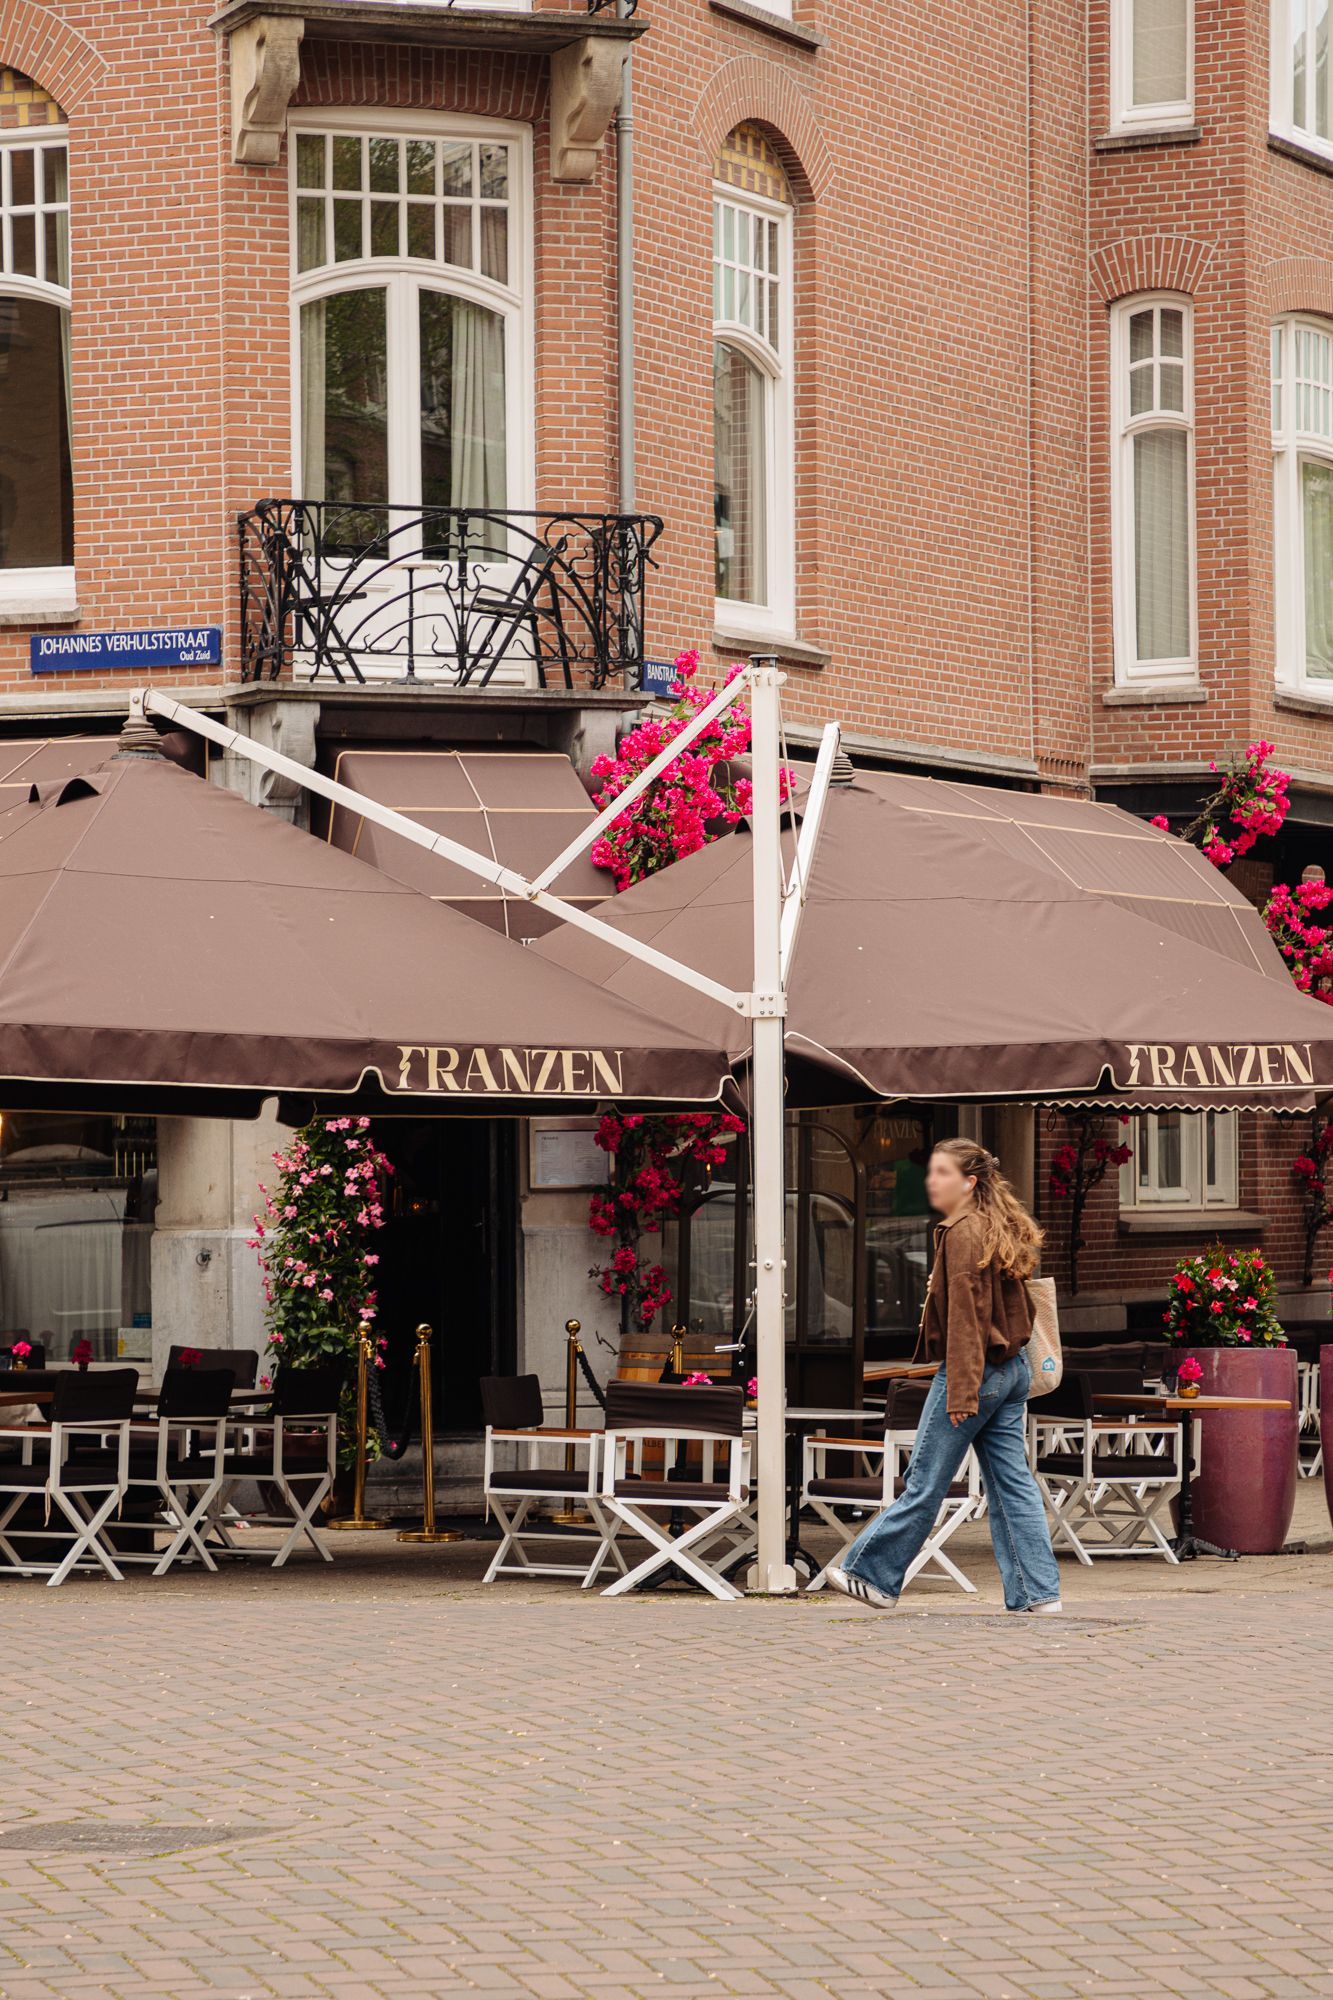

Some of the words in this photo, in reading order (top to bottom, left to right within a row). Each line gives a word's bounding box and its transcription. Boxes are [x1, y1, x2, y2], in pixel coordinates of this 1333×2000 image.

[39, 636, 102, 655] JOHANNES
[106, 631, 210, 652] VERHULSTSTRAAT
[179, 650, 194, 661] Oud
[195, 649, 211, 660] Zuid
[647, 663, 678, 682] BANSTRAA
[396, 1045, 623, 1094] FRANZEN
[1124, 1043, 1314, 1086] FRANZEN
